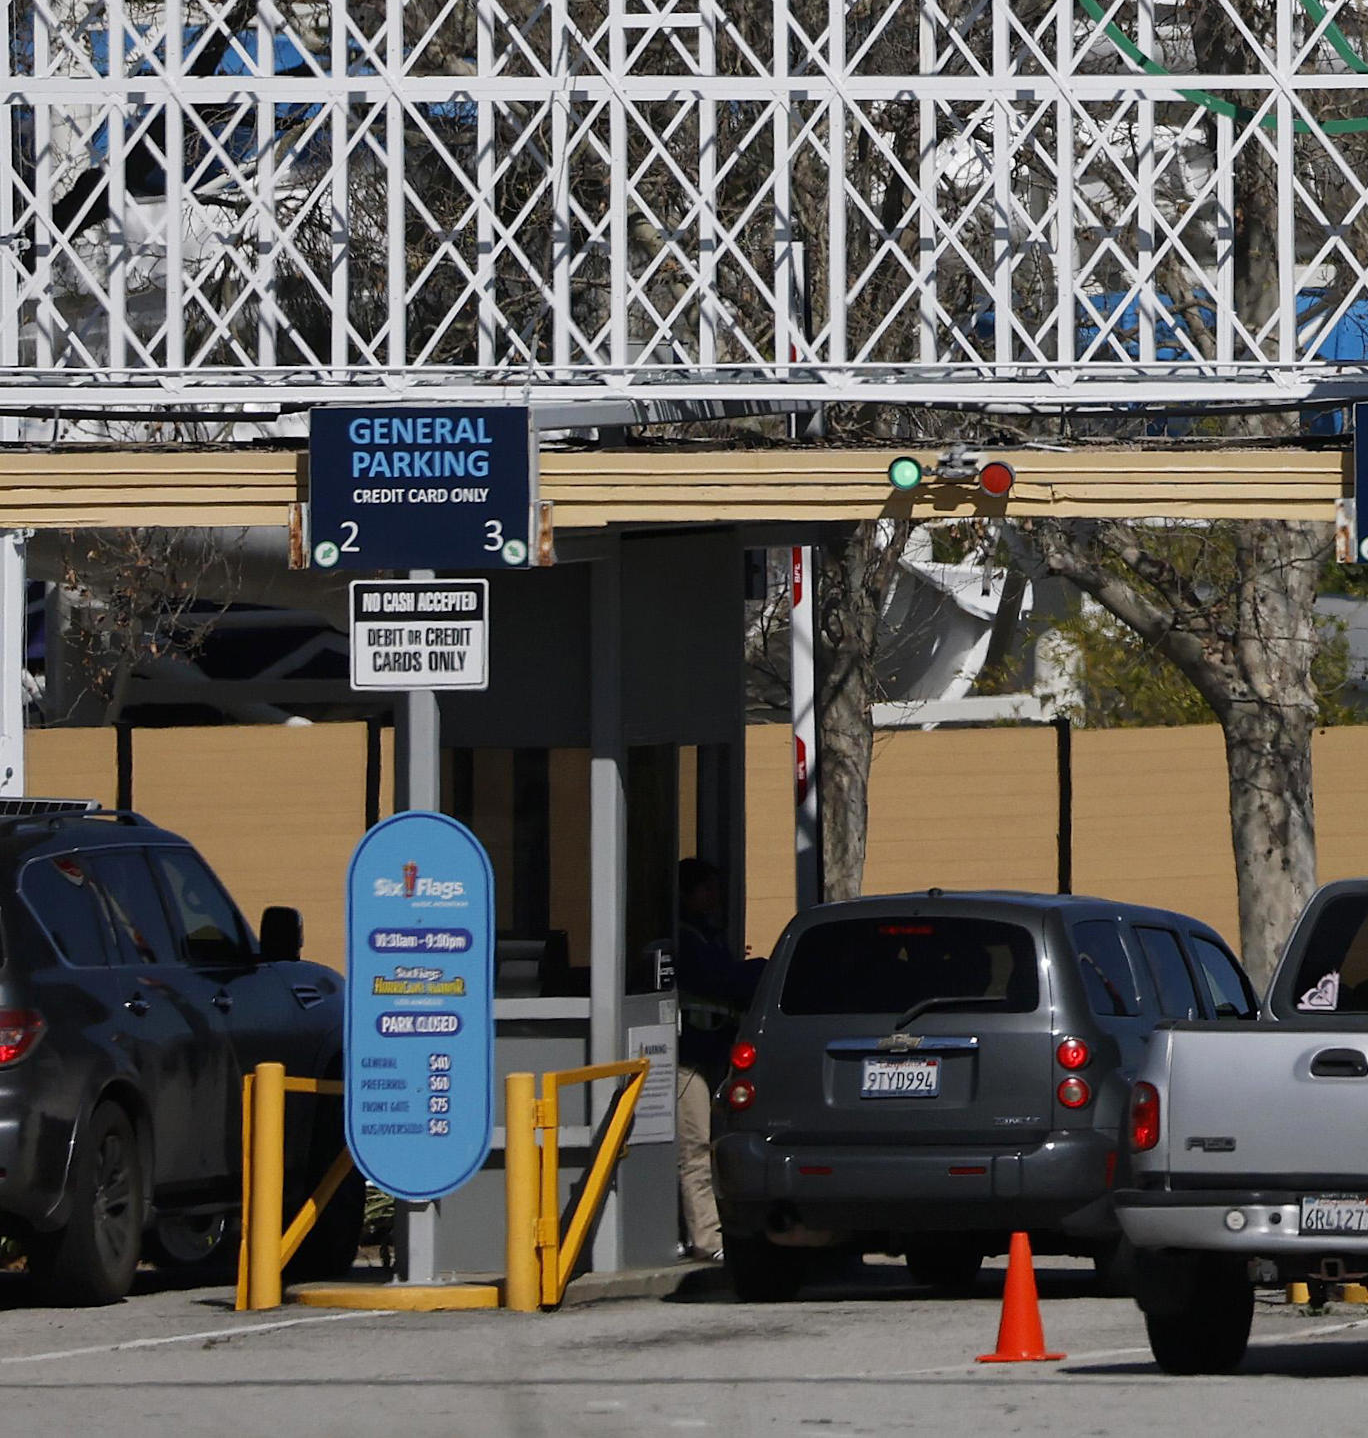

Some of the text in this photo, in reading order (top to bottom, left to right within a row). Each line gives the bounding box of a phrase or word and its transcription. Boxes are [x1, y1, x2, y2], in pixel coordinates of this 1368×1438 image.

[349, 418, 493, 444] GENERAL
[352, 450, 490, 478] PARKING
[353, 488, 489, 504] CREDIT CARD ONLY
[339, 521, 360, 552] 2
[484, 519, 505, 551] 3
[362, 591, 478, 613] NO CASH ACCEPTED
[367, 627, 472, 647] DEBIT OR CREDIT
[372, 651, 467, 672] CARDS ONLY
[374, 877, 465, 900] Six Flags
[381, 1016, 415, 1033] PARK
[867, 1072, 933, 1090] 9TYD994
[430, 1097, 449, 1113] $75
[429, 1120, 449, 1136] $45
